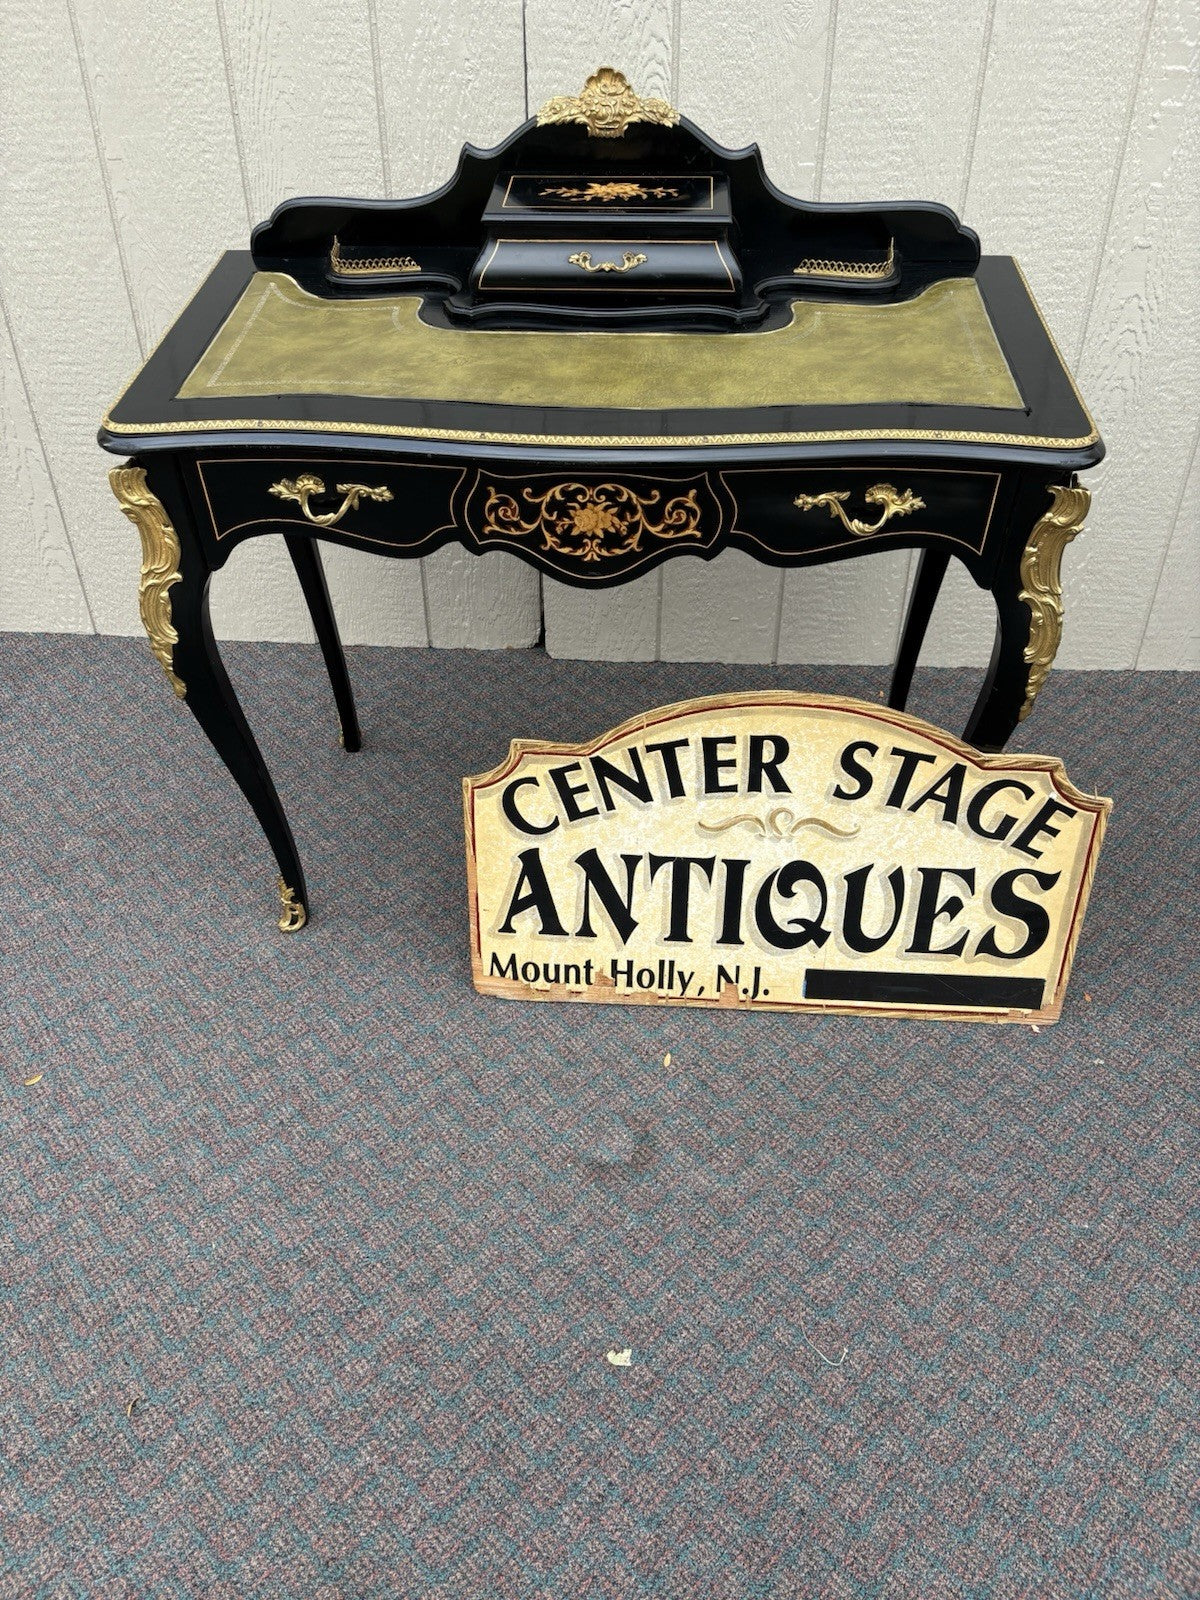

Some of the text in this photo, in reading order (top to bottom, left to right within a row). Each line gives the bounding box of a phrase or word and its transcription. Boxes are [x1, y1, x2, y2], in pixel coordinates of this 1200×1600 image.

[500, 735, 1077, 858] CENTER STAGE
[498, 847, 1062, 960] ANTIQUES
[490, 952, 770, 999] Mount Holly, N.J.
